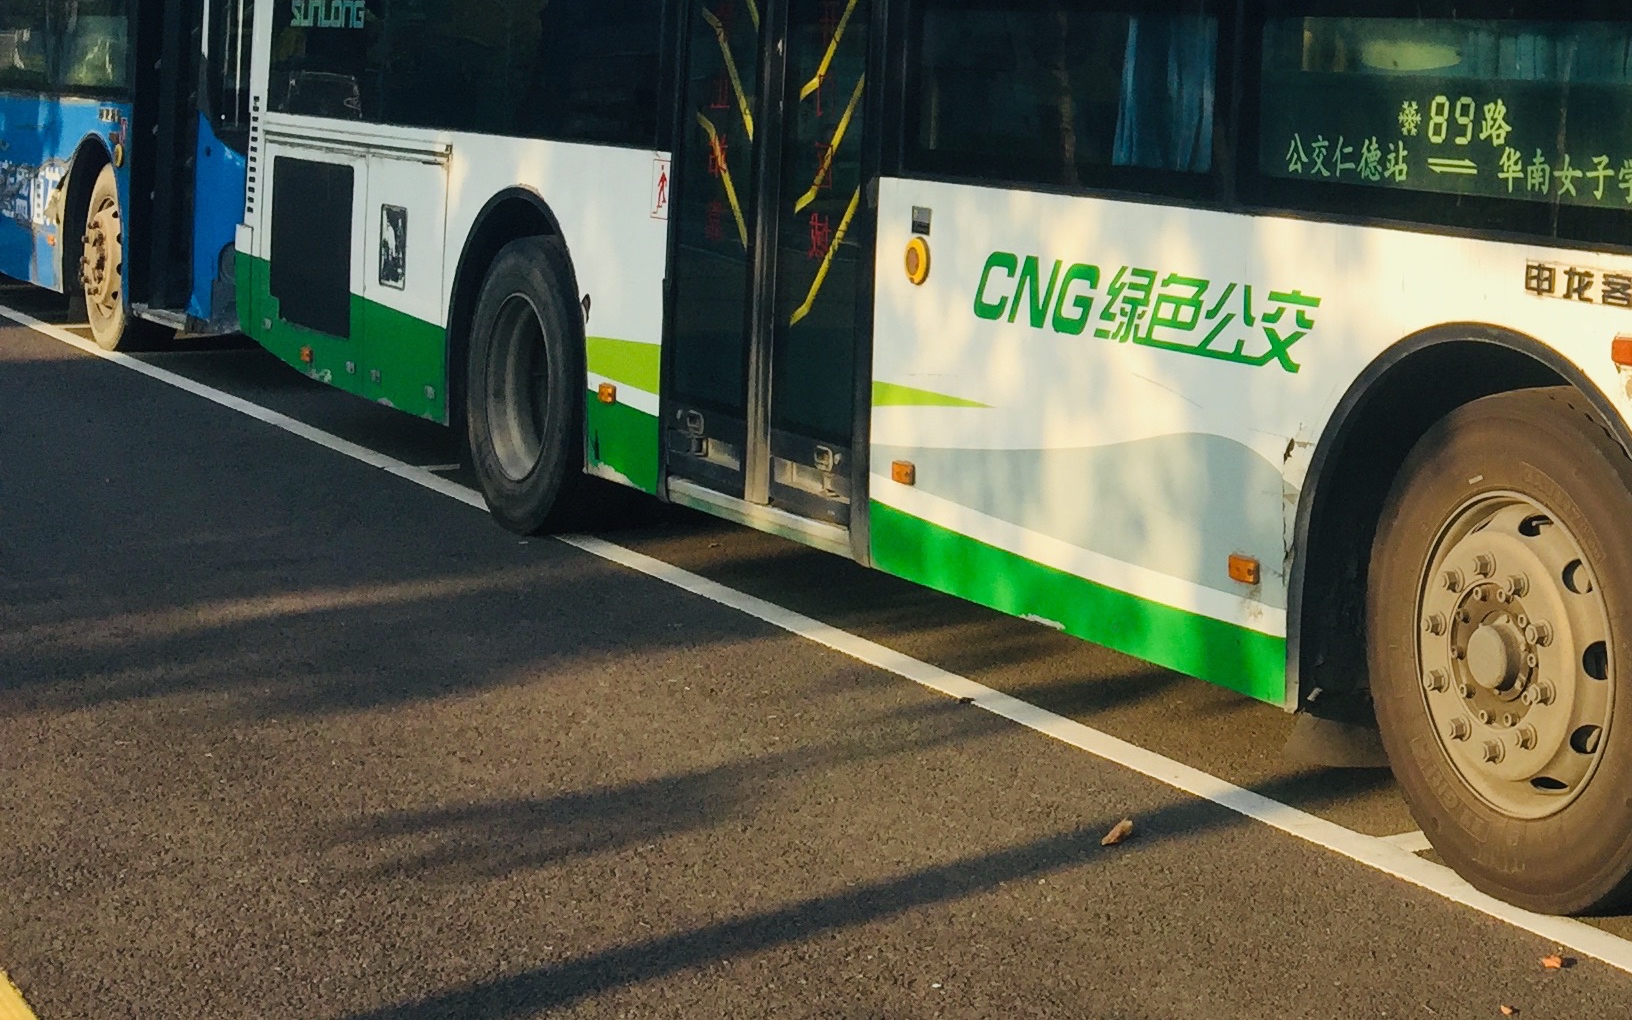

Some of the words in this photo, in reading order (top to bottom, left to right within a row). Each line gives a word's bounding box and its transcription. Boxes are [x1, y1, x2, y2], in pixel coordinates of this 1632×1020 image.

[290, 0, 366, 29] SUNLONG
[1286, 132, 1409, 183] 公交仁德站
